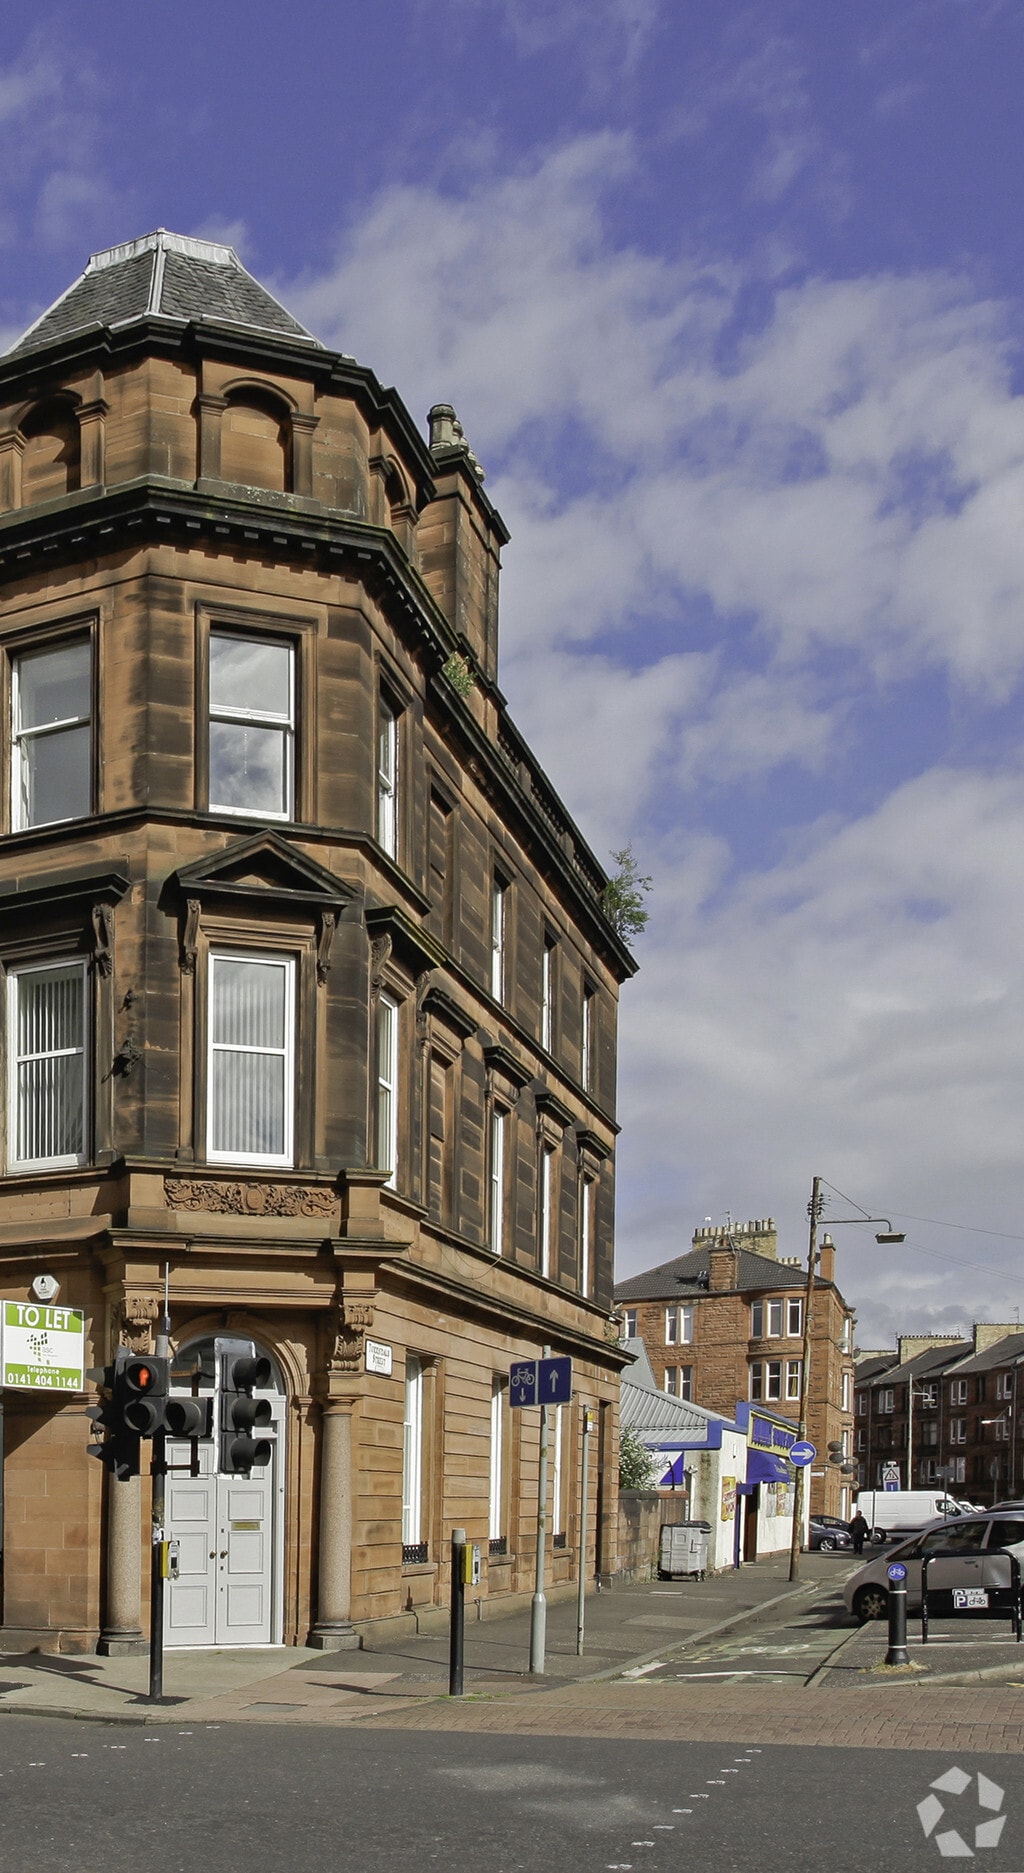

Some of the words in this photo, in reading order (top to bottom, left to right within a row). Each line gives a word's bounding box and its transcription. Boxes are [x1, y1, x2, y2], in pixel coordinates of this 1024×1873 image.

[16, 1305, 40, 1327] TO
[45, 1309, 70, 1330] LET
[27, 1366, 60, 1375] Telephone
[7, 1373, 31, 1385] 0141
[34, 1374, 53, 1386] 404
[56, 1376, 78, 1388] 1144
[956, 1596, 966, 1607] P
